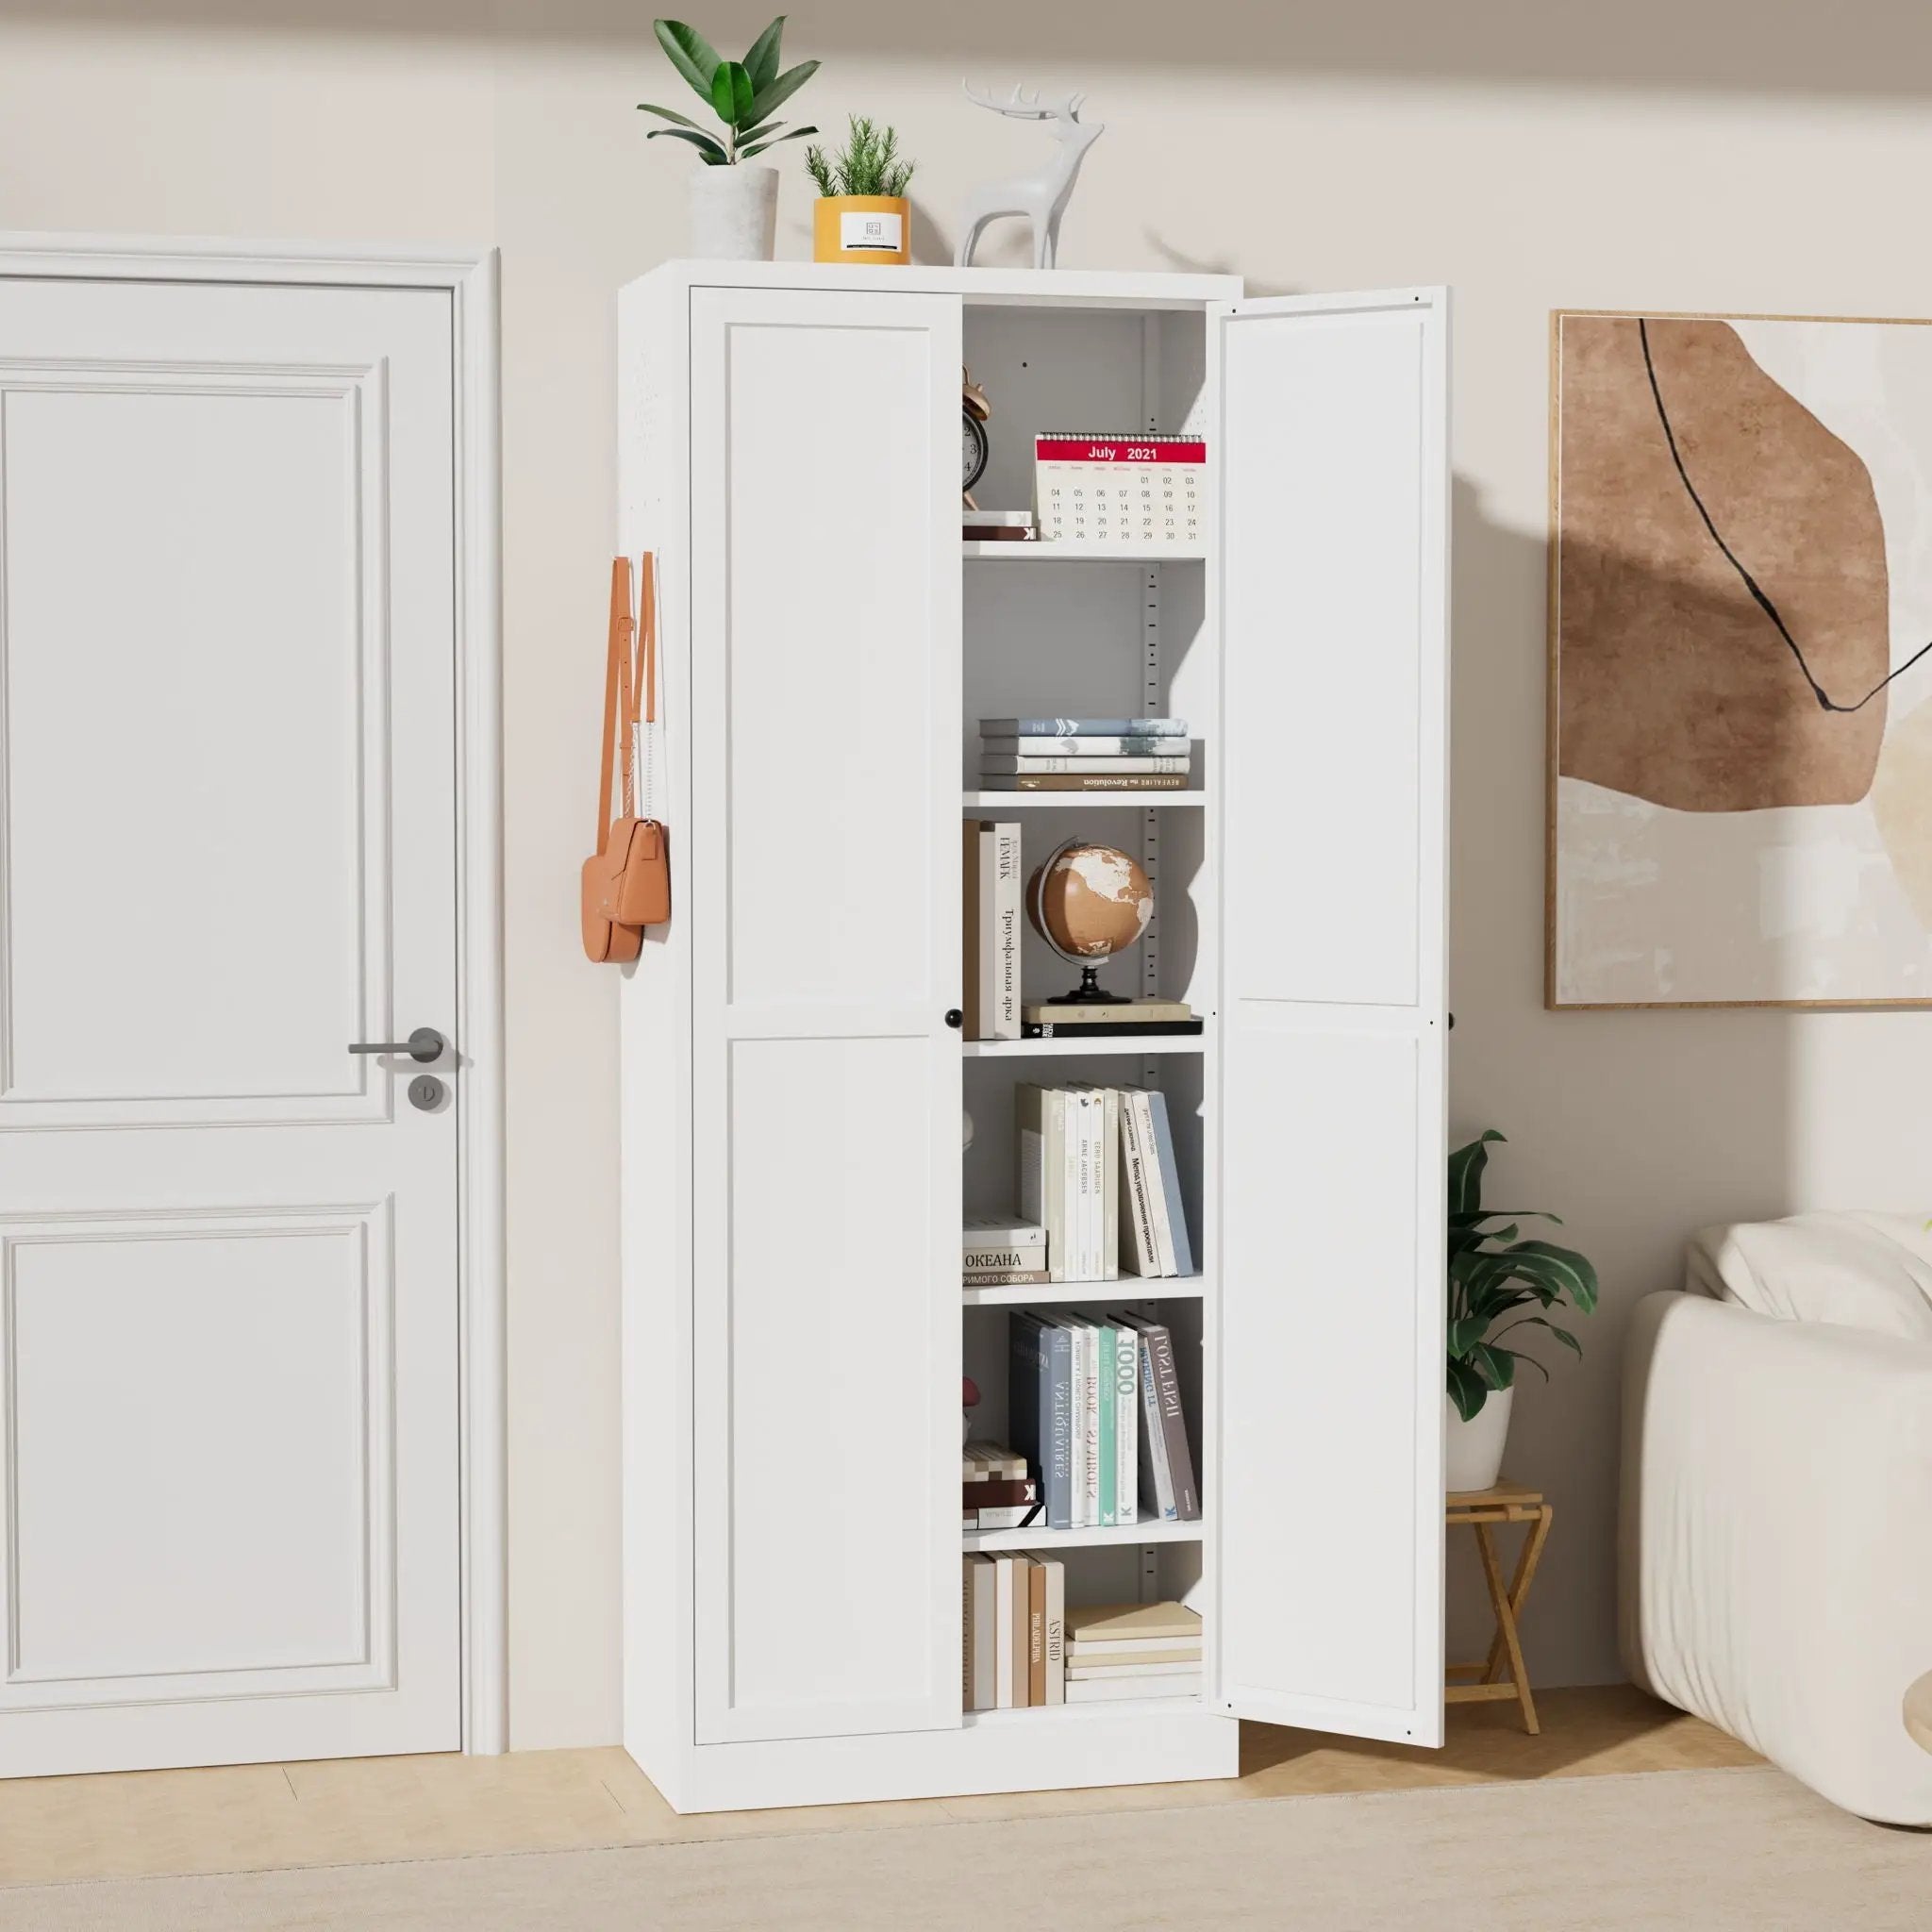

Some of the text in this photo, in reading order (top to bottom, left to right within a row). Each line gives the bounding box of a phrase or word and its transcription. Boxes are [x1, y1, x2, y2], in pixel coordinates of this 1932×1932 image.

[964, 427, 971, 437] 2
[970, 444, 977, 455] 3
[1088, 446, 1157, 461] July 2021
[964, 462, 971, 472] 4
[1162, 476, 1173, 485] 02
[1185, 476, 1195, 485] 03
[1051, 488, 1195, 499] 04 05 06 07 08 09 10
[1074, 503, 1084, 511] 12
[1097, 503, 1107, 511] 13
[1120, 503, 1128, 511] 14
[1142, 504, 1151, 512] 15
[1165, 504, 1174, 512] 16
[1053, 516, 1062, 525] 18
[1075, 516, 1085, 525] 19
[1097, 517, 1107, 525] 20
[1120, 517, 1128, 525] 21
[1142, 517, 1152, 526] 22
[1187, 518, 1197, 526] 24
[1053, 530, 1061, 539] 25
[1075, 530, 1086, 540] 26
[1098, 530, 1108, 540] 27
[1121, 531, 1130, 541] 28
[1165, 531, 1175, 541] 30
[1188, 532, 1196, 541] 31
[1083, 778, 1128, 787] Revolution
[1002, 908, 1016, 1022] Триумфальная арка
[1132, 1158, 1141, 1182] Метод
[1142, 1225, 1156, 1264] проектами
[965, 1253, 1022, 1268] ОКЕАНА
[1000, 1274, 1035, 1284] СОБОРА
[1031, 1612, 1041, 1664] PHILADELPHIA
[1049, 1619, 1061, 1661] ASTRID
